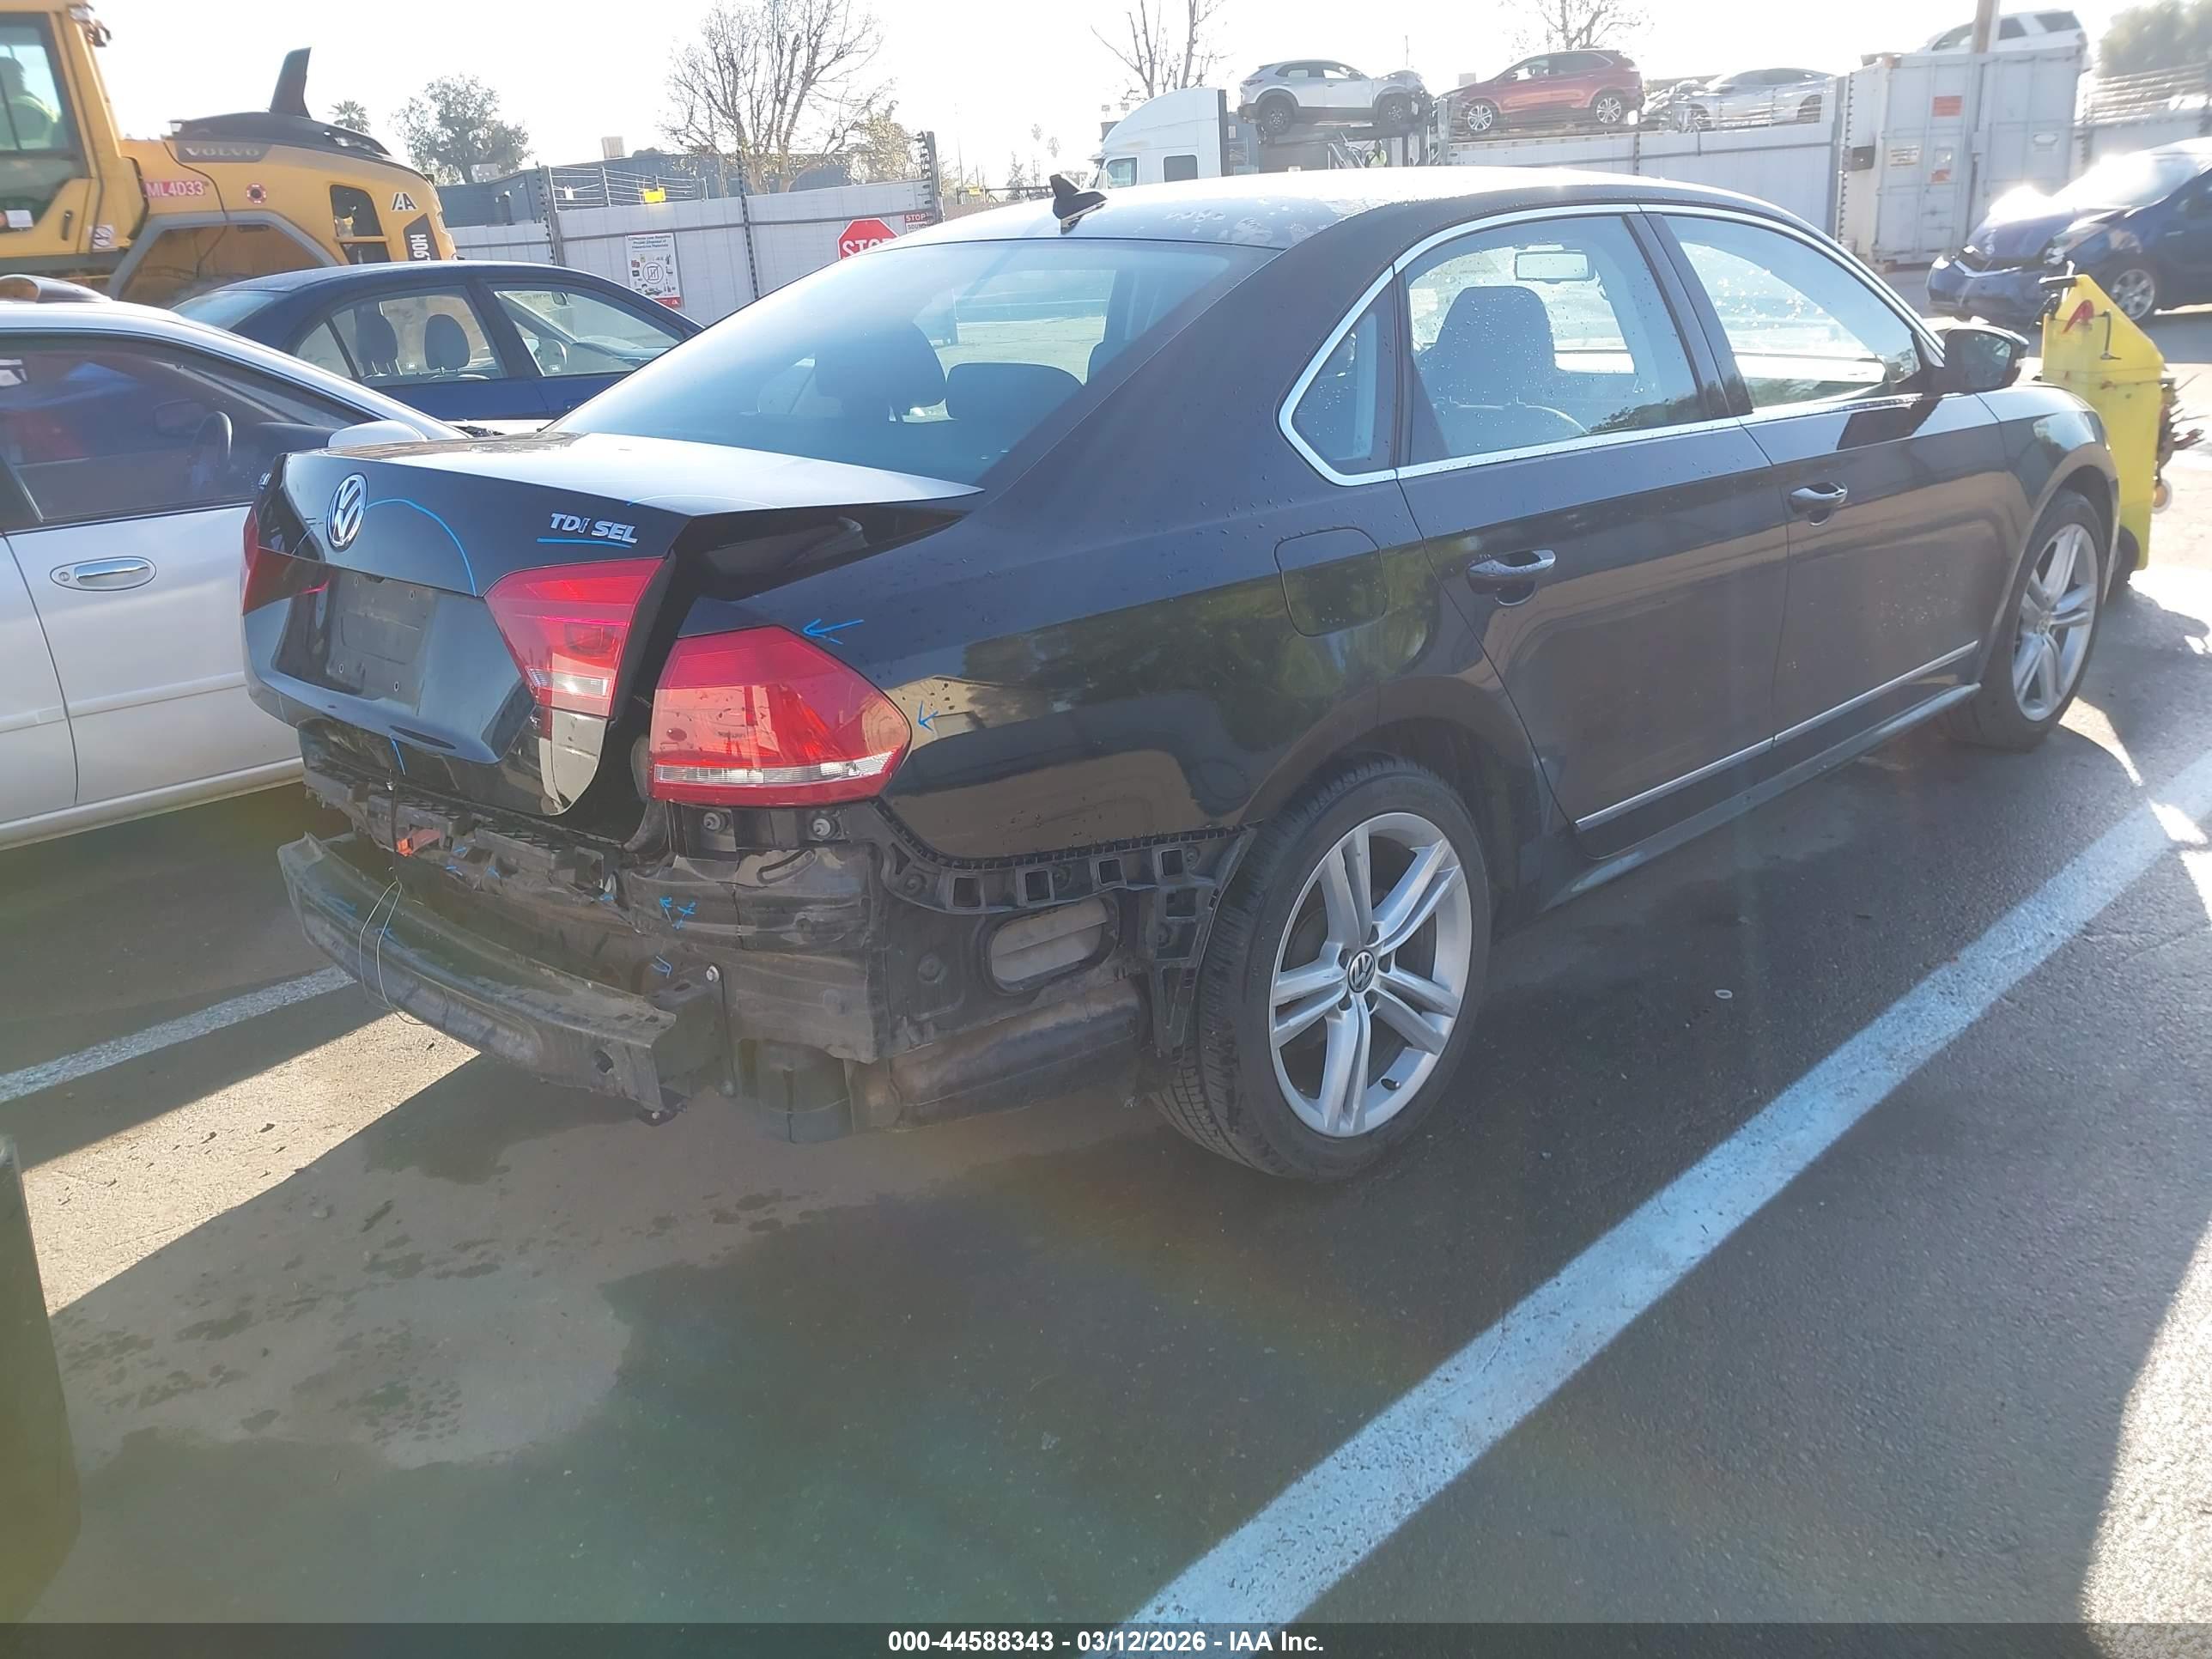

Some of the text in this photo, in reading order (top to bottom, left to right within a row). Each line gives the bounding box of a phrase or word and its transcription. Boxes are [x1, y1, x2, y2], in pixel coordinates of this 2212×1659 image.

[185, 147, 259, 157] VOLVO
[410, 234, 431, 261] 90H
[550, 513, 638, 544] TDI SEL
